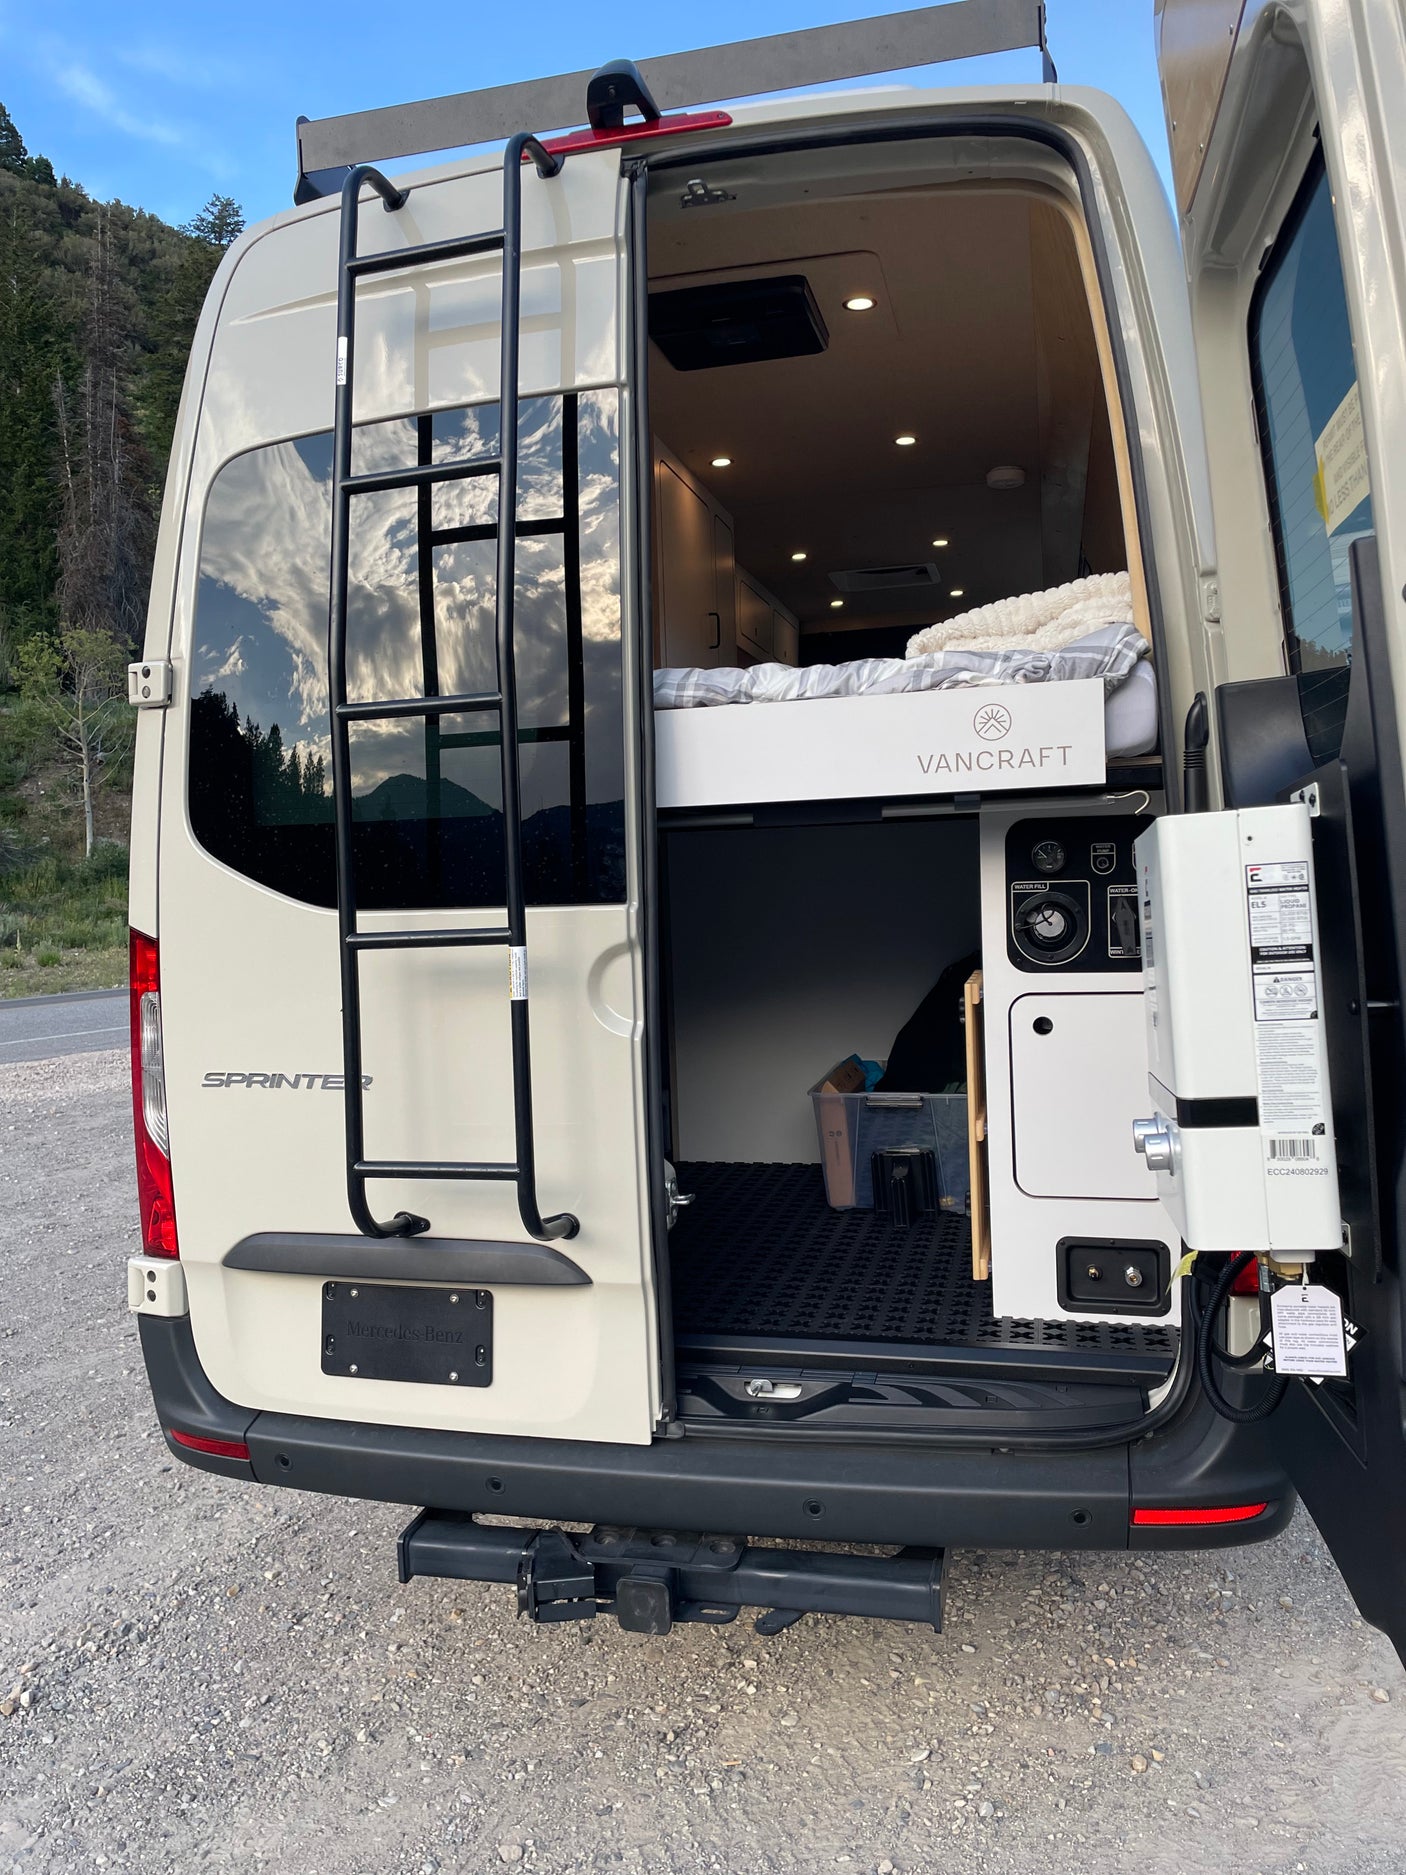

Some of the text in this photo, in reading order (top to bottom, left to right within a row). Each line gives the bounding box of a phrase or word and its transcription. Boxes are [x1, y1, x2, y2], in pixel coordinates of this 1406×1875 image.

[1334, 479, 1349, 509] LESS
[917, 746, 1072, 774] VANCRAFT
[201, 1072, 373, 1090] SPRINTER
[346, 1321, 465, 1344] Mercedes-Benz
